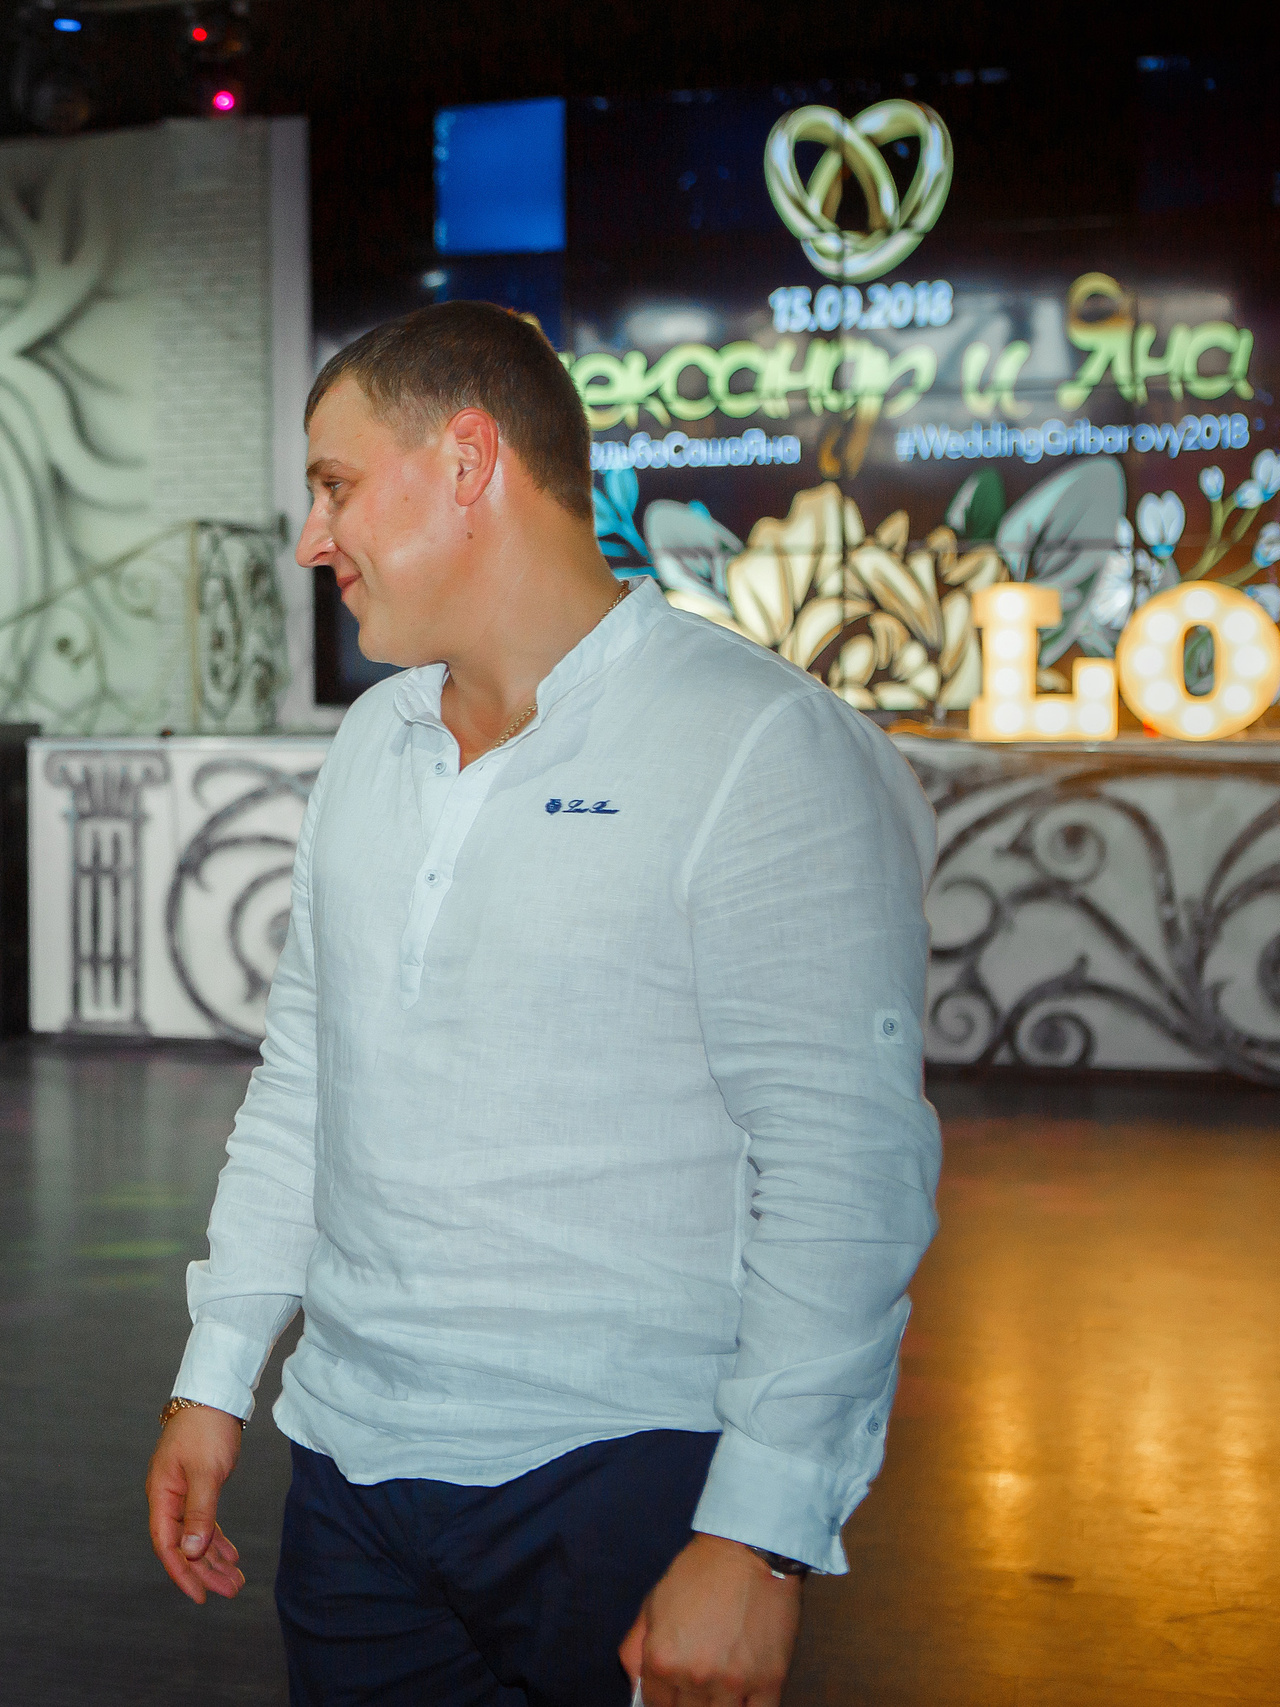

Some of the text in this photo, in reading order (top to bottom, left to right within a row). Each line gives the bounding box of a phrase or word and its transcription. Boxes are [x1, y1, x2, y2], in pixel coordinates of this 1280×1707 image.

[558, 335, 938, 478] ександр
[1056, 271, 1255, 412] Яна
[894, 412, 1251, 464] #WeddingGribarovy2018
